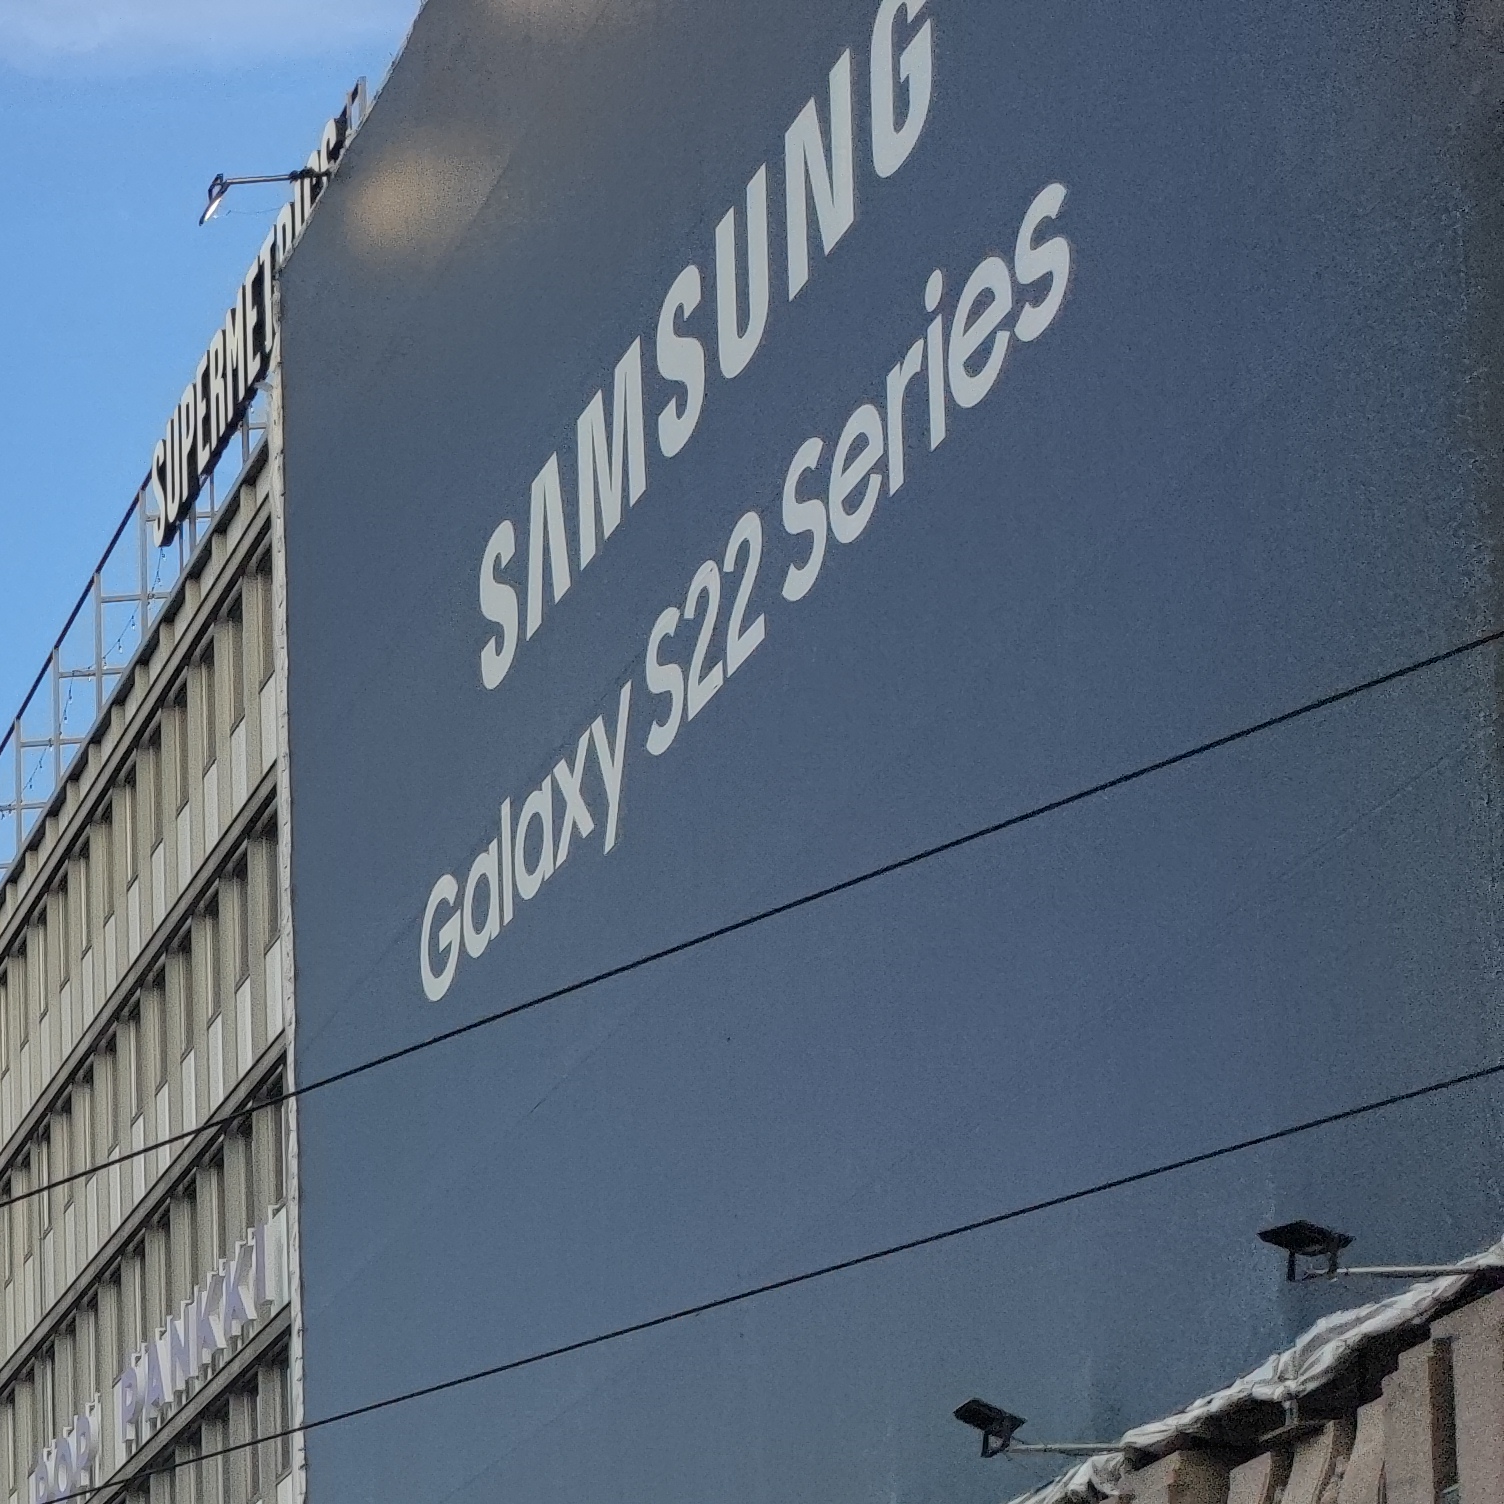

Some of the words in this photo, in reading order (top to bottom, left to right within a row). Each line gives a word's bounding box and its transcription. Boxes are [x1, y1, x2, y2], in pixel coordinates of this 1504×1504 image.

[419, 683, 632, 1001] Galaxy
[645, 511, 766, 756] S22
[783, 182, 1071, 602] Series
[480, 0, 932, 689] SAMSUNG
[121, 1222, 270, 1438] PANKKI
